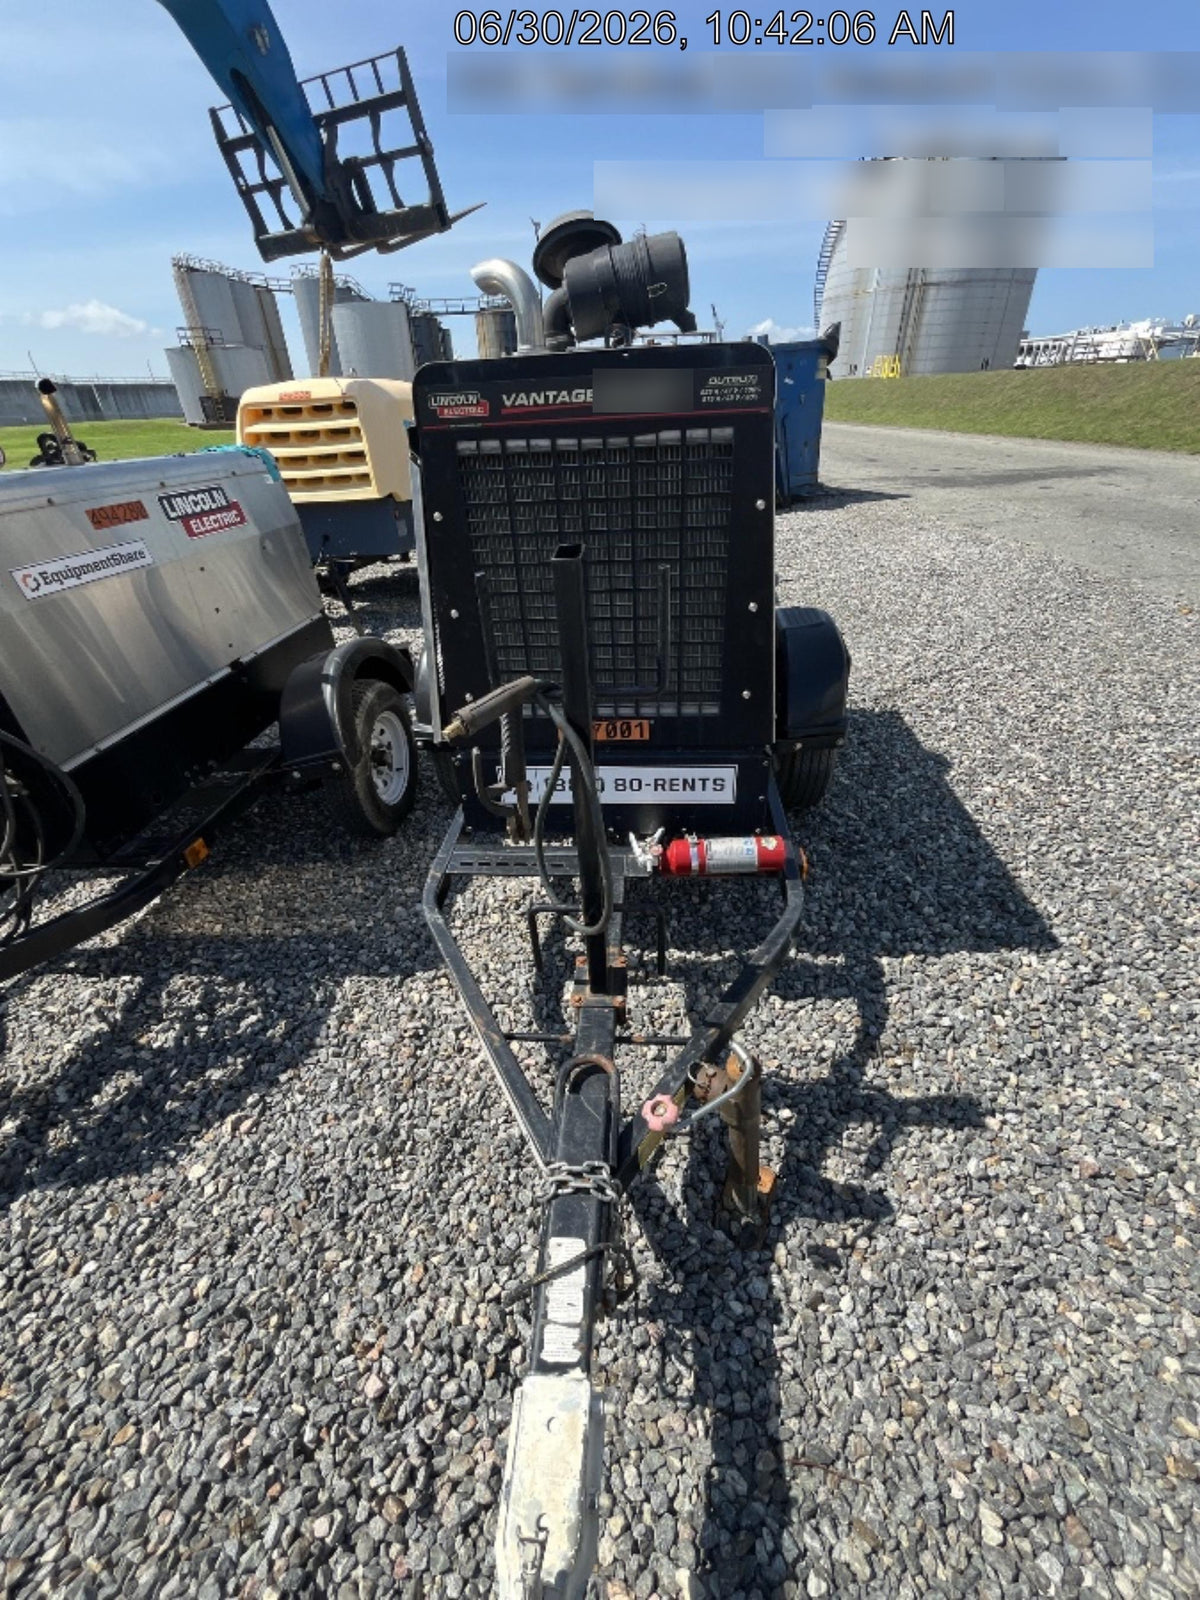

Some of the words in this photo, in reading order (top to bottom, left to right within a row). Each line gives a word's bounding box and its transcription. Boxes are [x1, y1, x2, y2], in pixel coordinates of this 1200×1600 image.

[431, 394, 478, 406] LINCOLN
[502, 389, 593, 407] VANTAGE
[443, 407, 485, 416] ELECTRIC
[162, 489, 228, 518] LINCOLN
[189, 509, 241, 533] ELECTRIC
[38, 548, 146, 586] EquipmentShare
[613, 777, 726, 793] 80-RENTS
